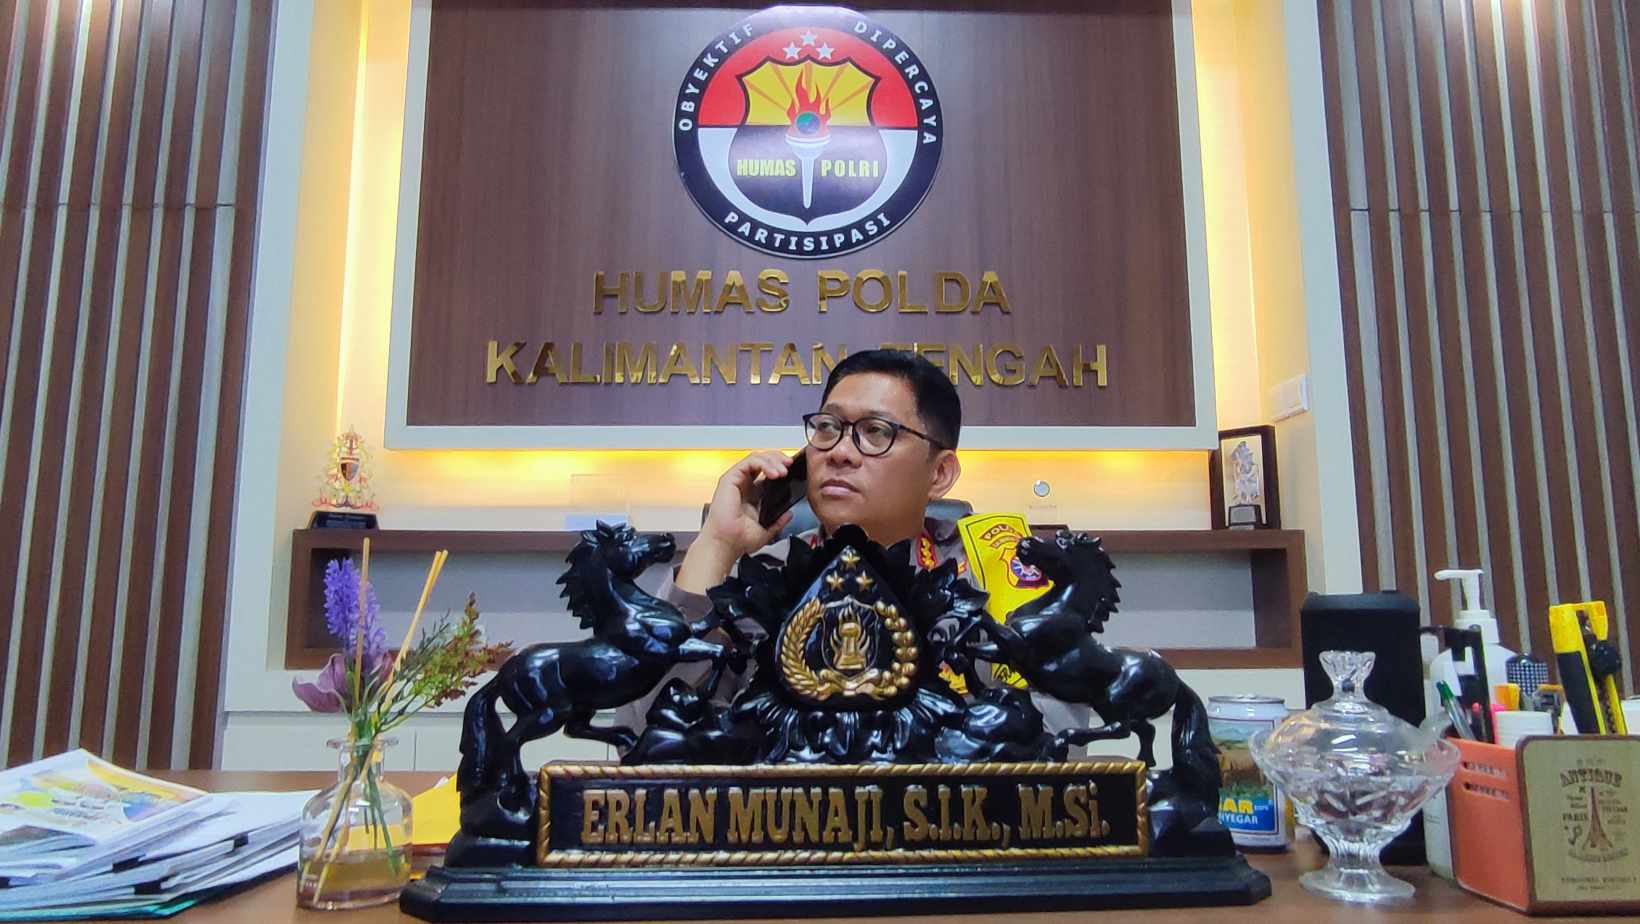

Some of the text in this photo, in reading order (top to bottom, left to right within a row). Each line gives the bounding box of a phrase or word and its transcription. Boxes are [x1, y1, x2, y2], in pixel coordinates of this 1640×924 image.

[678, 22, 753, 132] OBYEKTIF
[854, 21, 937, 144] DIPERCAYA
[736, 159, 880, 177] HUMAS POLRI
[724, 211, 891, 251] PARTISIPASI
[592, 269, 1012, 314] HUMAS POLDA
[485, 341, 1108, 388] KALIMANTAN ENGAH
[581, 779, 1112, 850] ERLAN MUNAJI, S.I.K., M.Si.
[1219, 797, 1255, 815] AR
